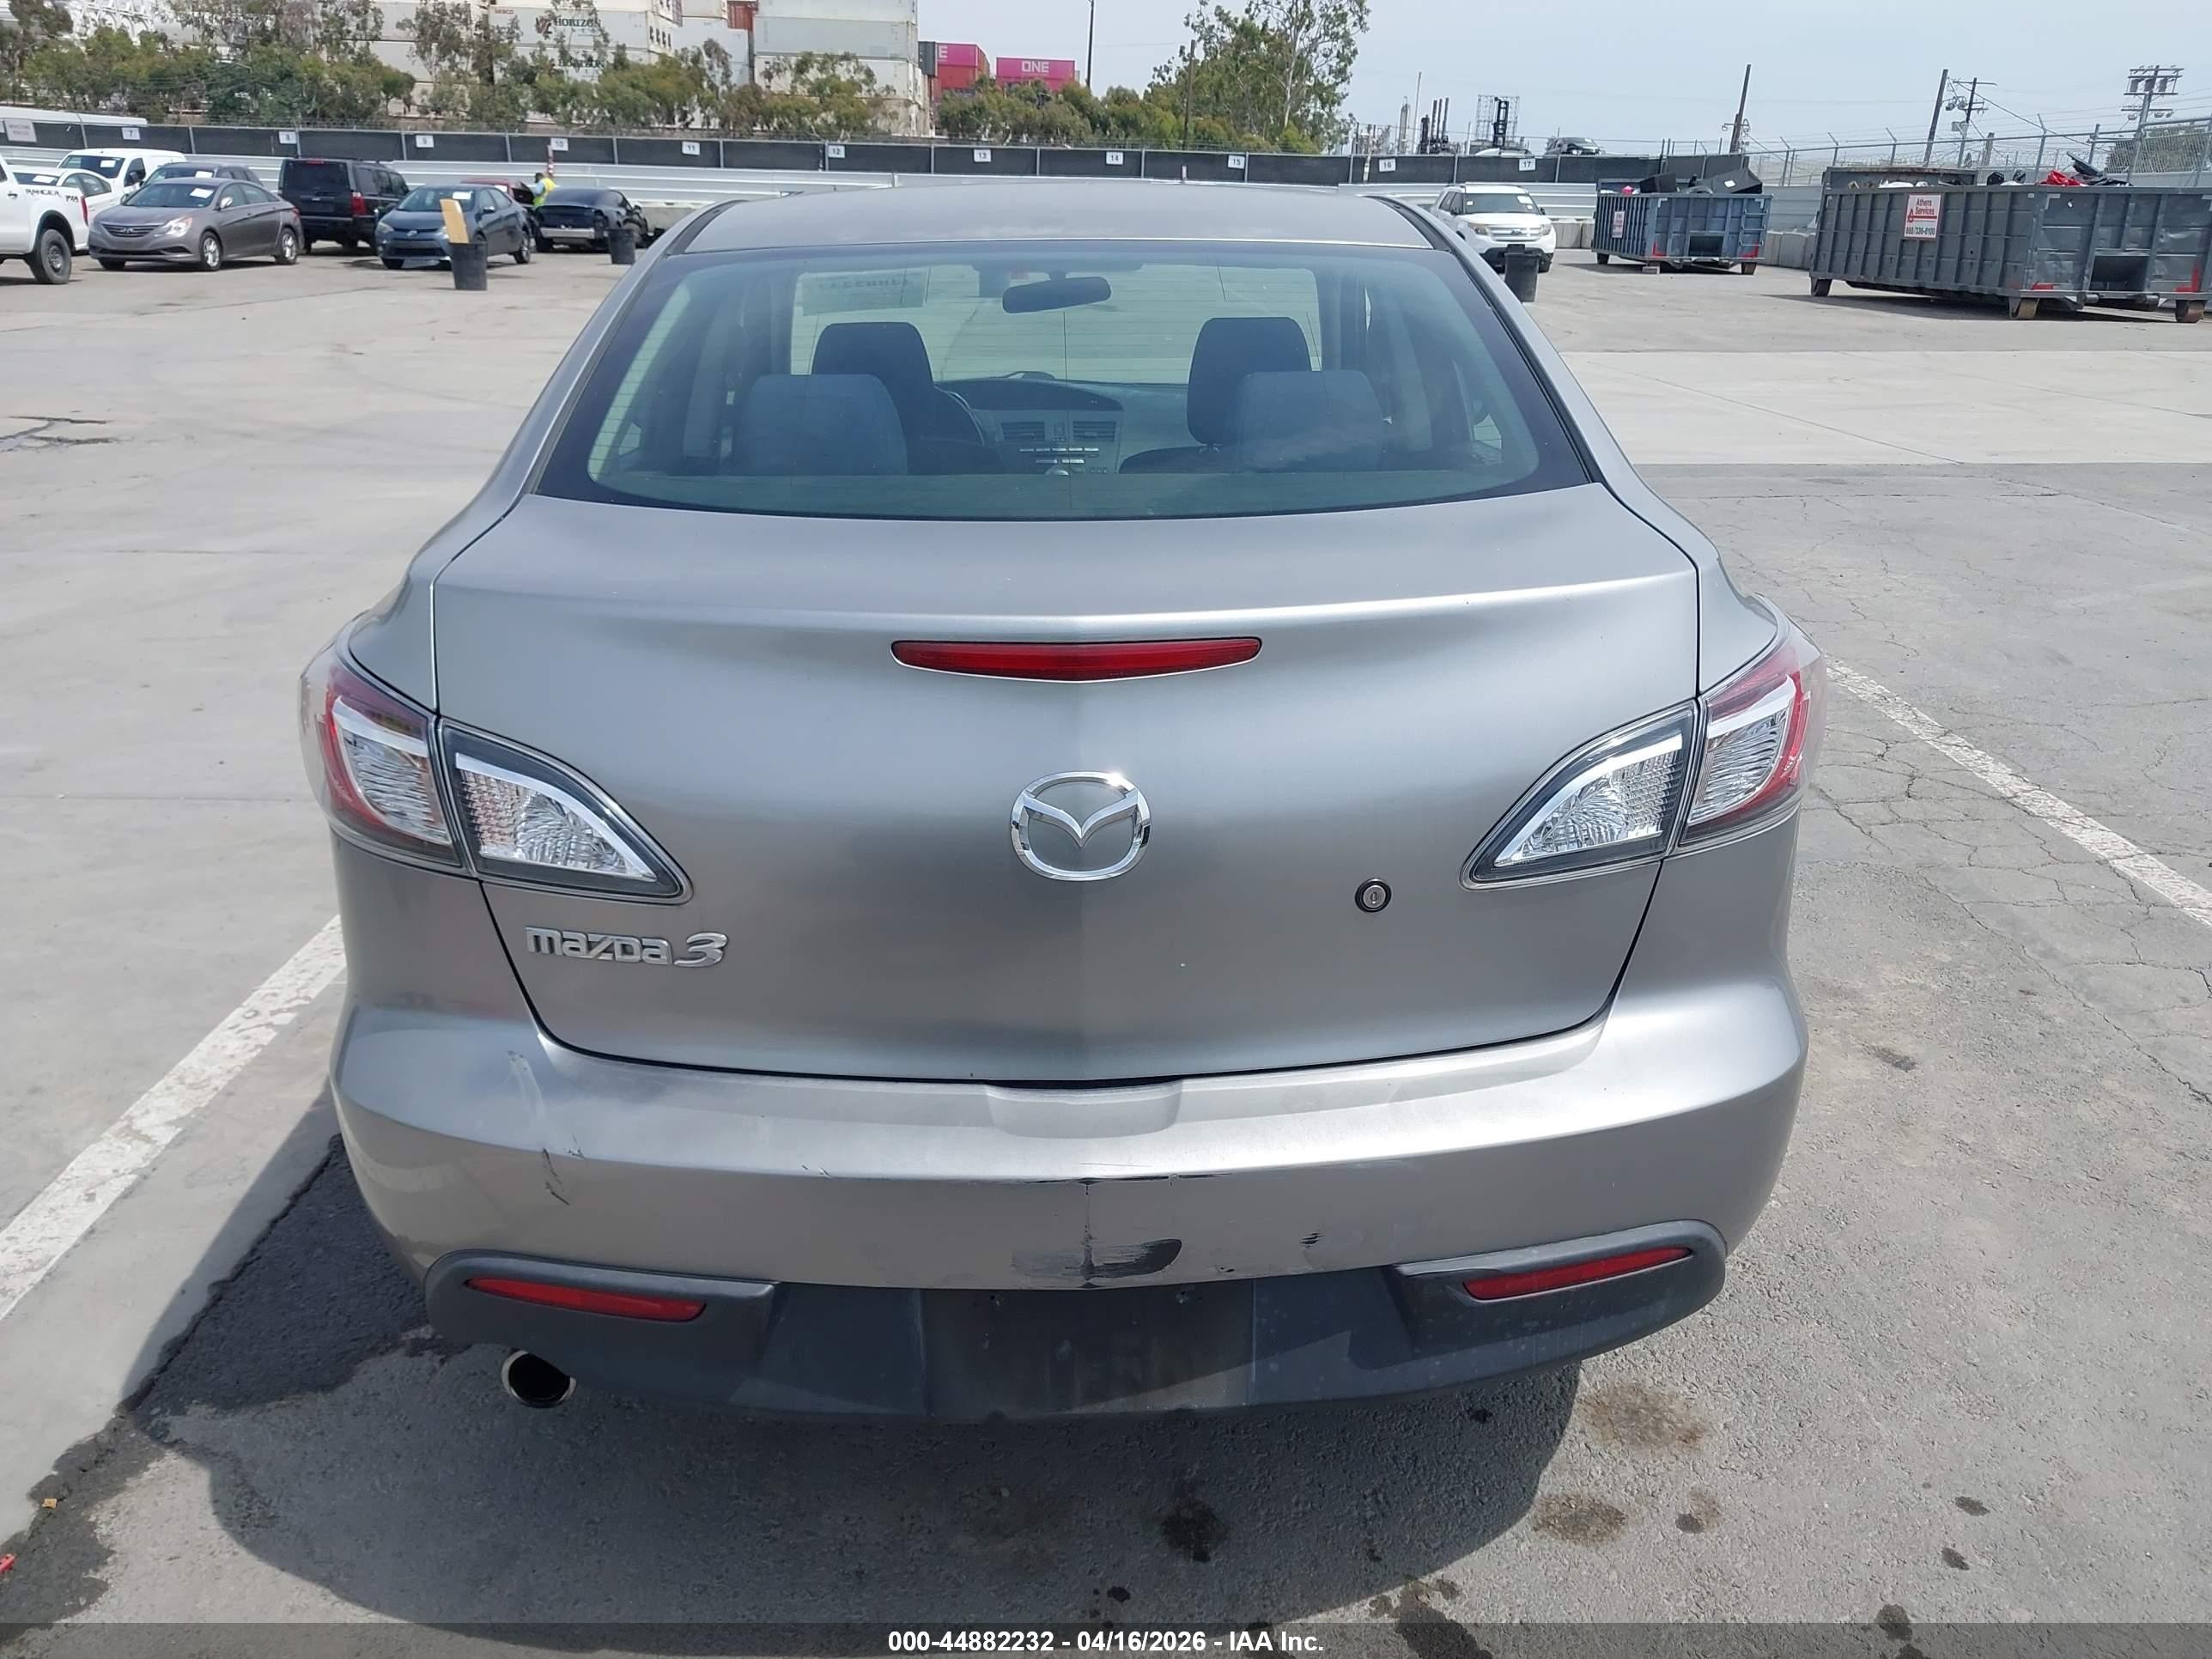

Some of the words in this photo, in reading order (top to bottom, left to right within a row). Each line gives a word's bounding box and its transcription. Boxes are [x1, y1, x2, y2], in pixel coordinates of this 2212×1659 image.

[1022, 61, 1049, 73] ONE
[1916, 198, 1932, 207] Athens
[1914, 206, 1935, 216] Services
[673, 932, 728, 968] 3
